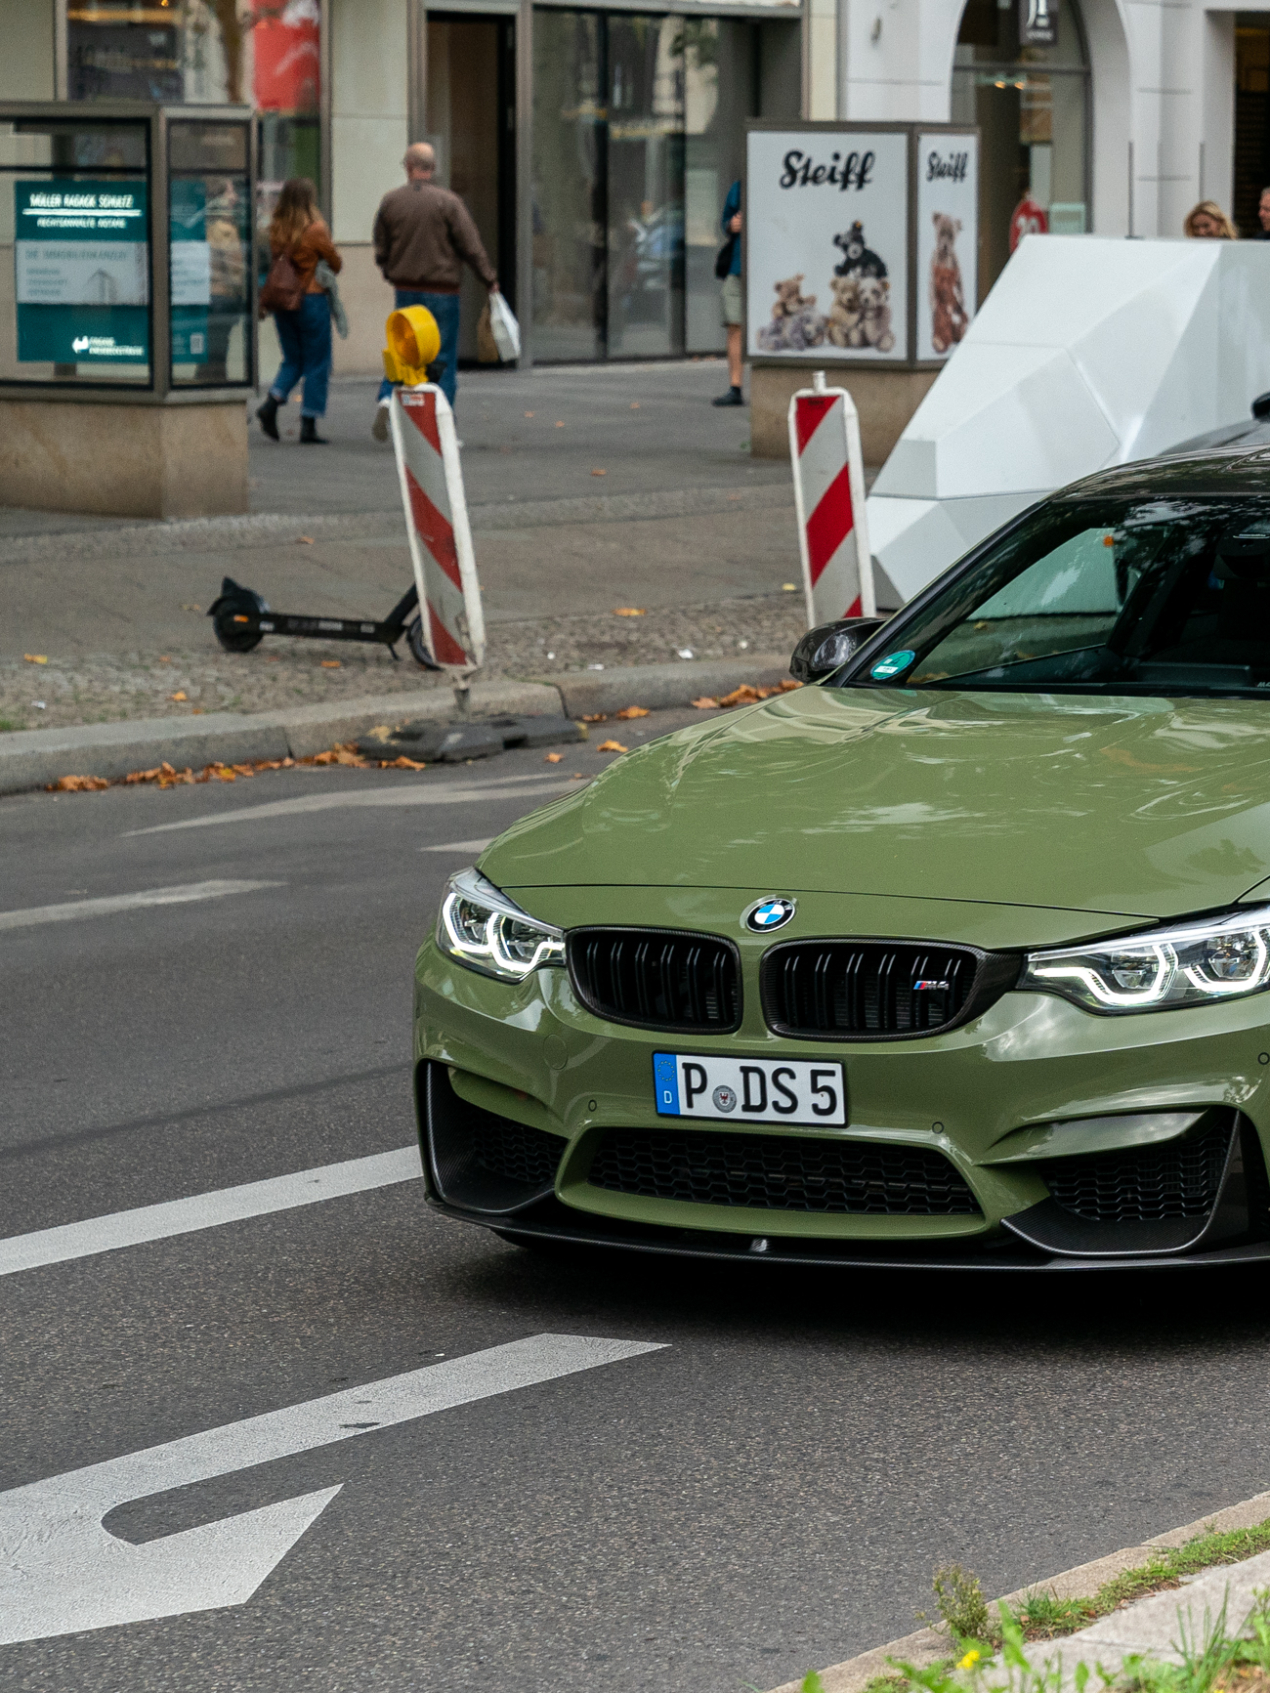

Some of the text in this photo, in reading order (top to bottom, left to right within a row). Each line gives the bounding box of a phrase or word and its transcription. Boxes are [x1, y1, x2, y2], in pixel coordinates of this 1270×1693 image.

[779, 148, 875, 191] Steiff
[927, 151, 968, 183] Steiff
[30, 192, 62, 207] MÜLLER
[663, 1090, 673, 1104] D
[682, 1062, 837, 1116] P DS 5
